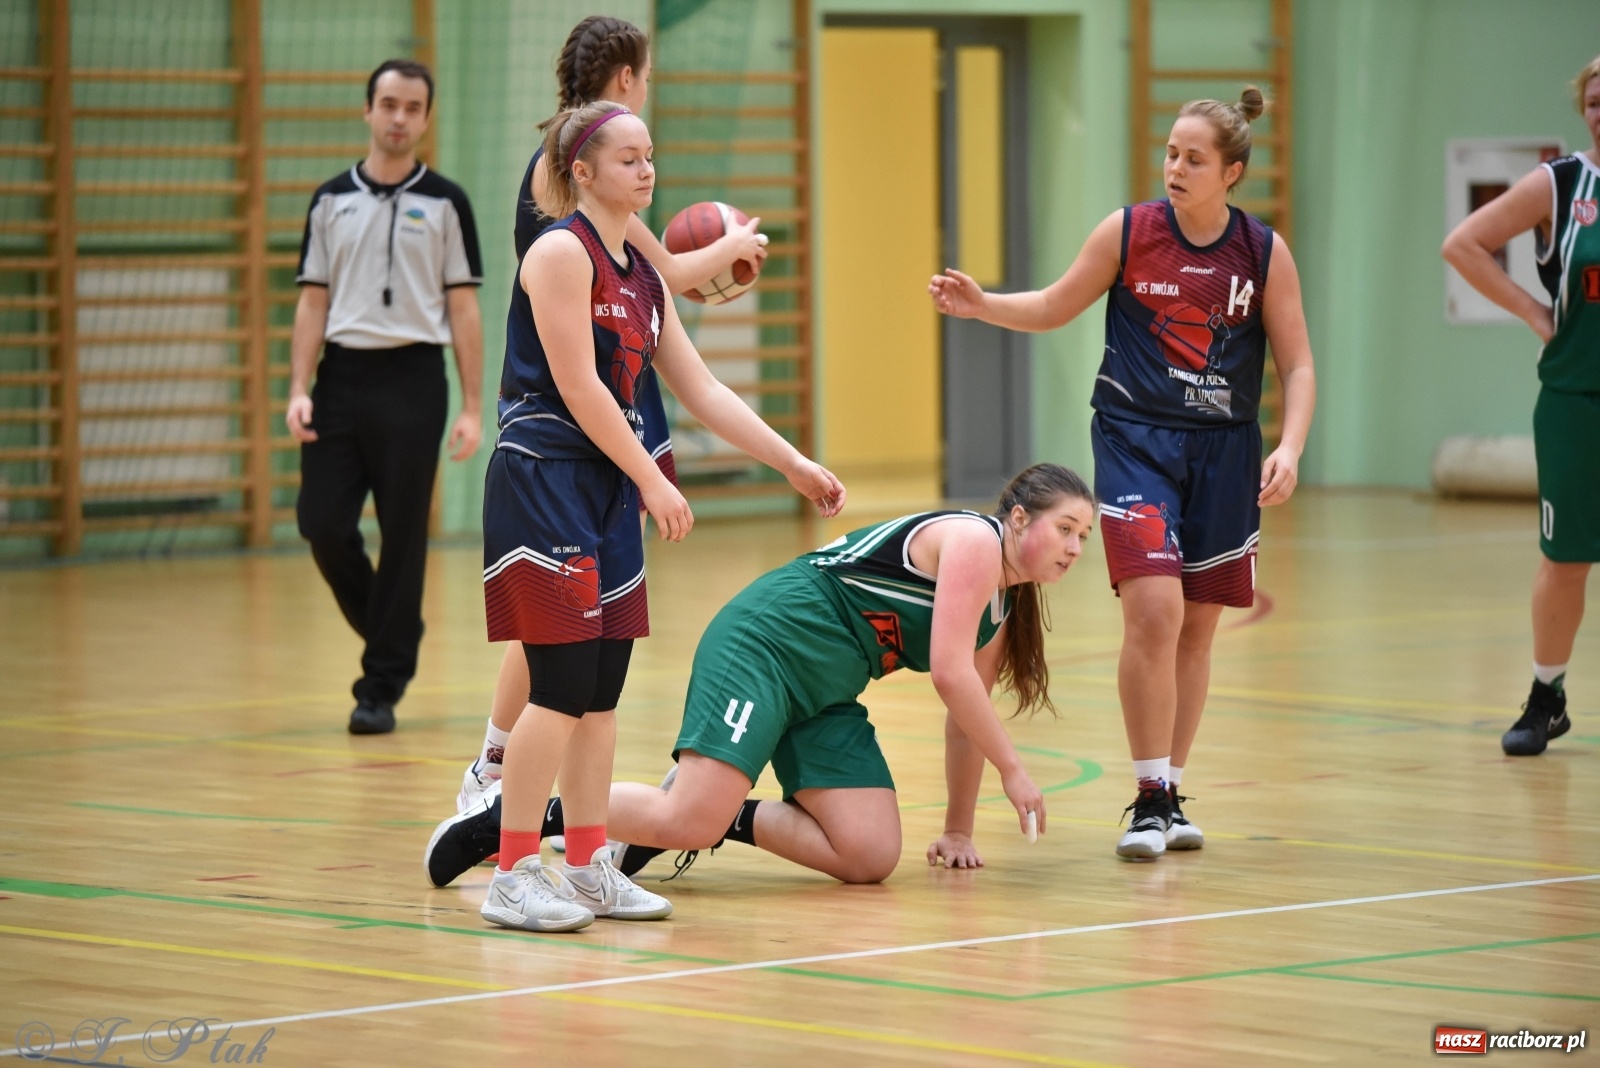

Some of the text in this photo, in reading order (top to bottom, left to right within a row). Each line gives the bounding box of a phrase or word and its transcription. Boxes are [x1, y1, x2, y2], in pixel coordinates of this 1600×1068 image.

[1150, 281, 1179, 297] DWÓJKA
[1227, 275, 1254, 316] 14
[594, 304, 609, 316] UKS
[562, 545, 581, 553] DWÓJKA
[724, 698, 754, 744] 4
